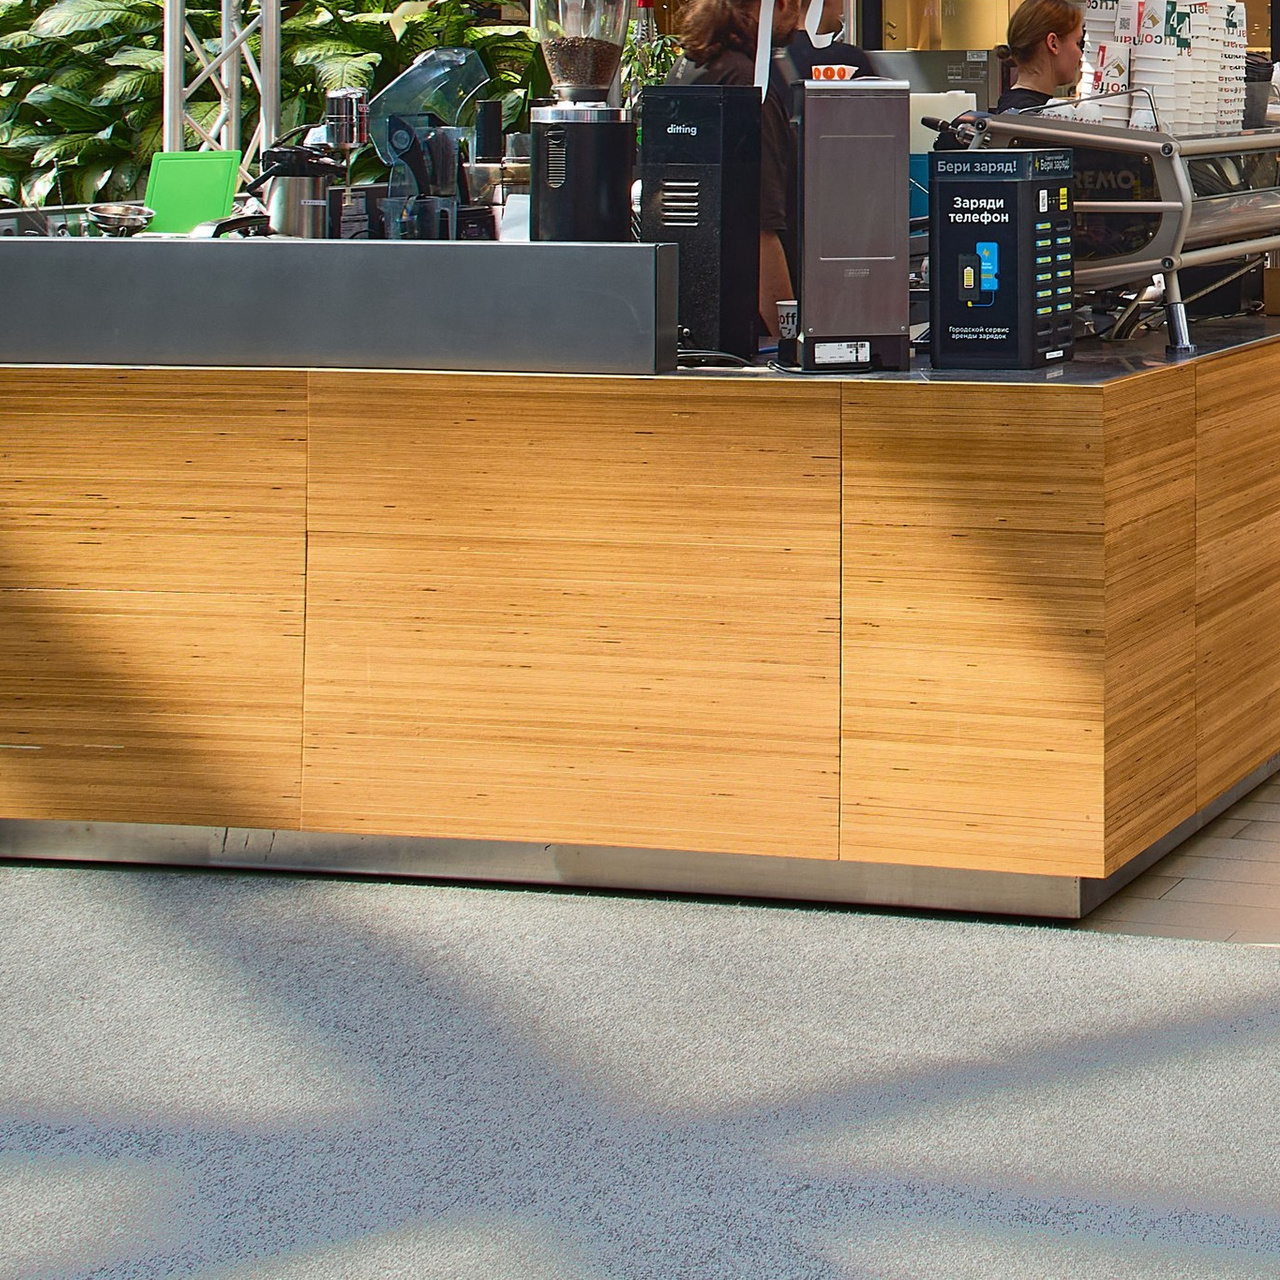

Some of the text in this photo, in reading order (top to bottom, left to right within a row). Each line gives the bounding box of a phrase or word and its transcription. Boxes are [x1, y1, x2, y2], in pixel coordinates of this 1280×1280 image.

[667, 124, 697, 136] ditting
[937, 160, 1017, 174] Бери заряд!
[1040, 159, 1053, 172] Бери
[953, 197, 1005, 210] Заряди
[948, 212, 1009, 225] телефон
[949, 326, 984, 334] Городской
